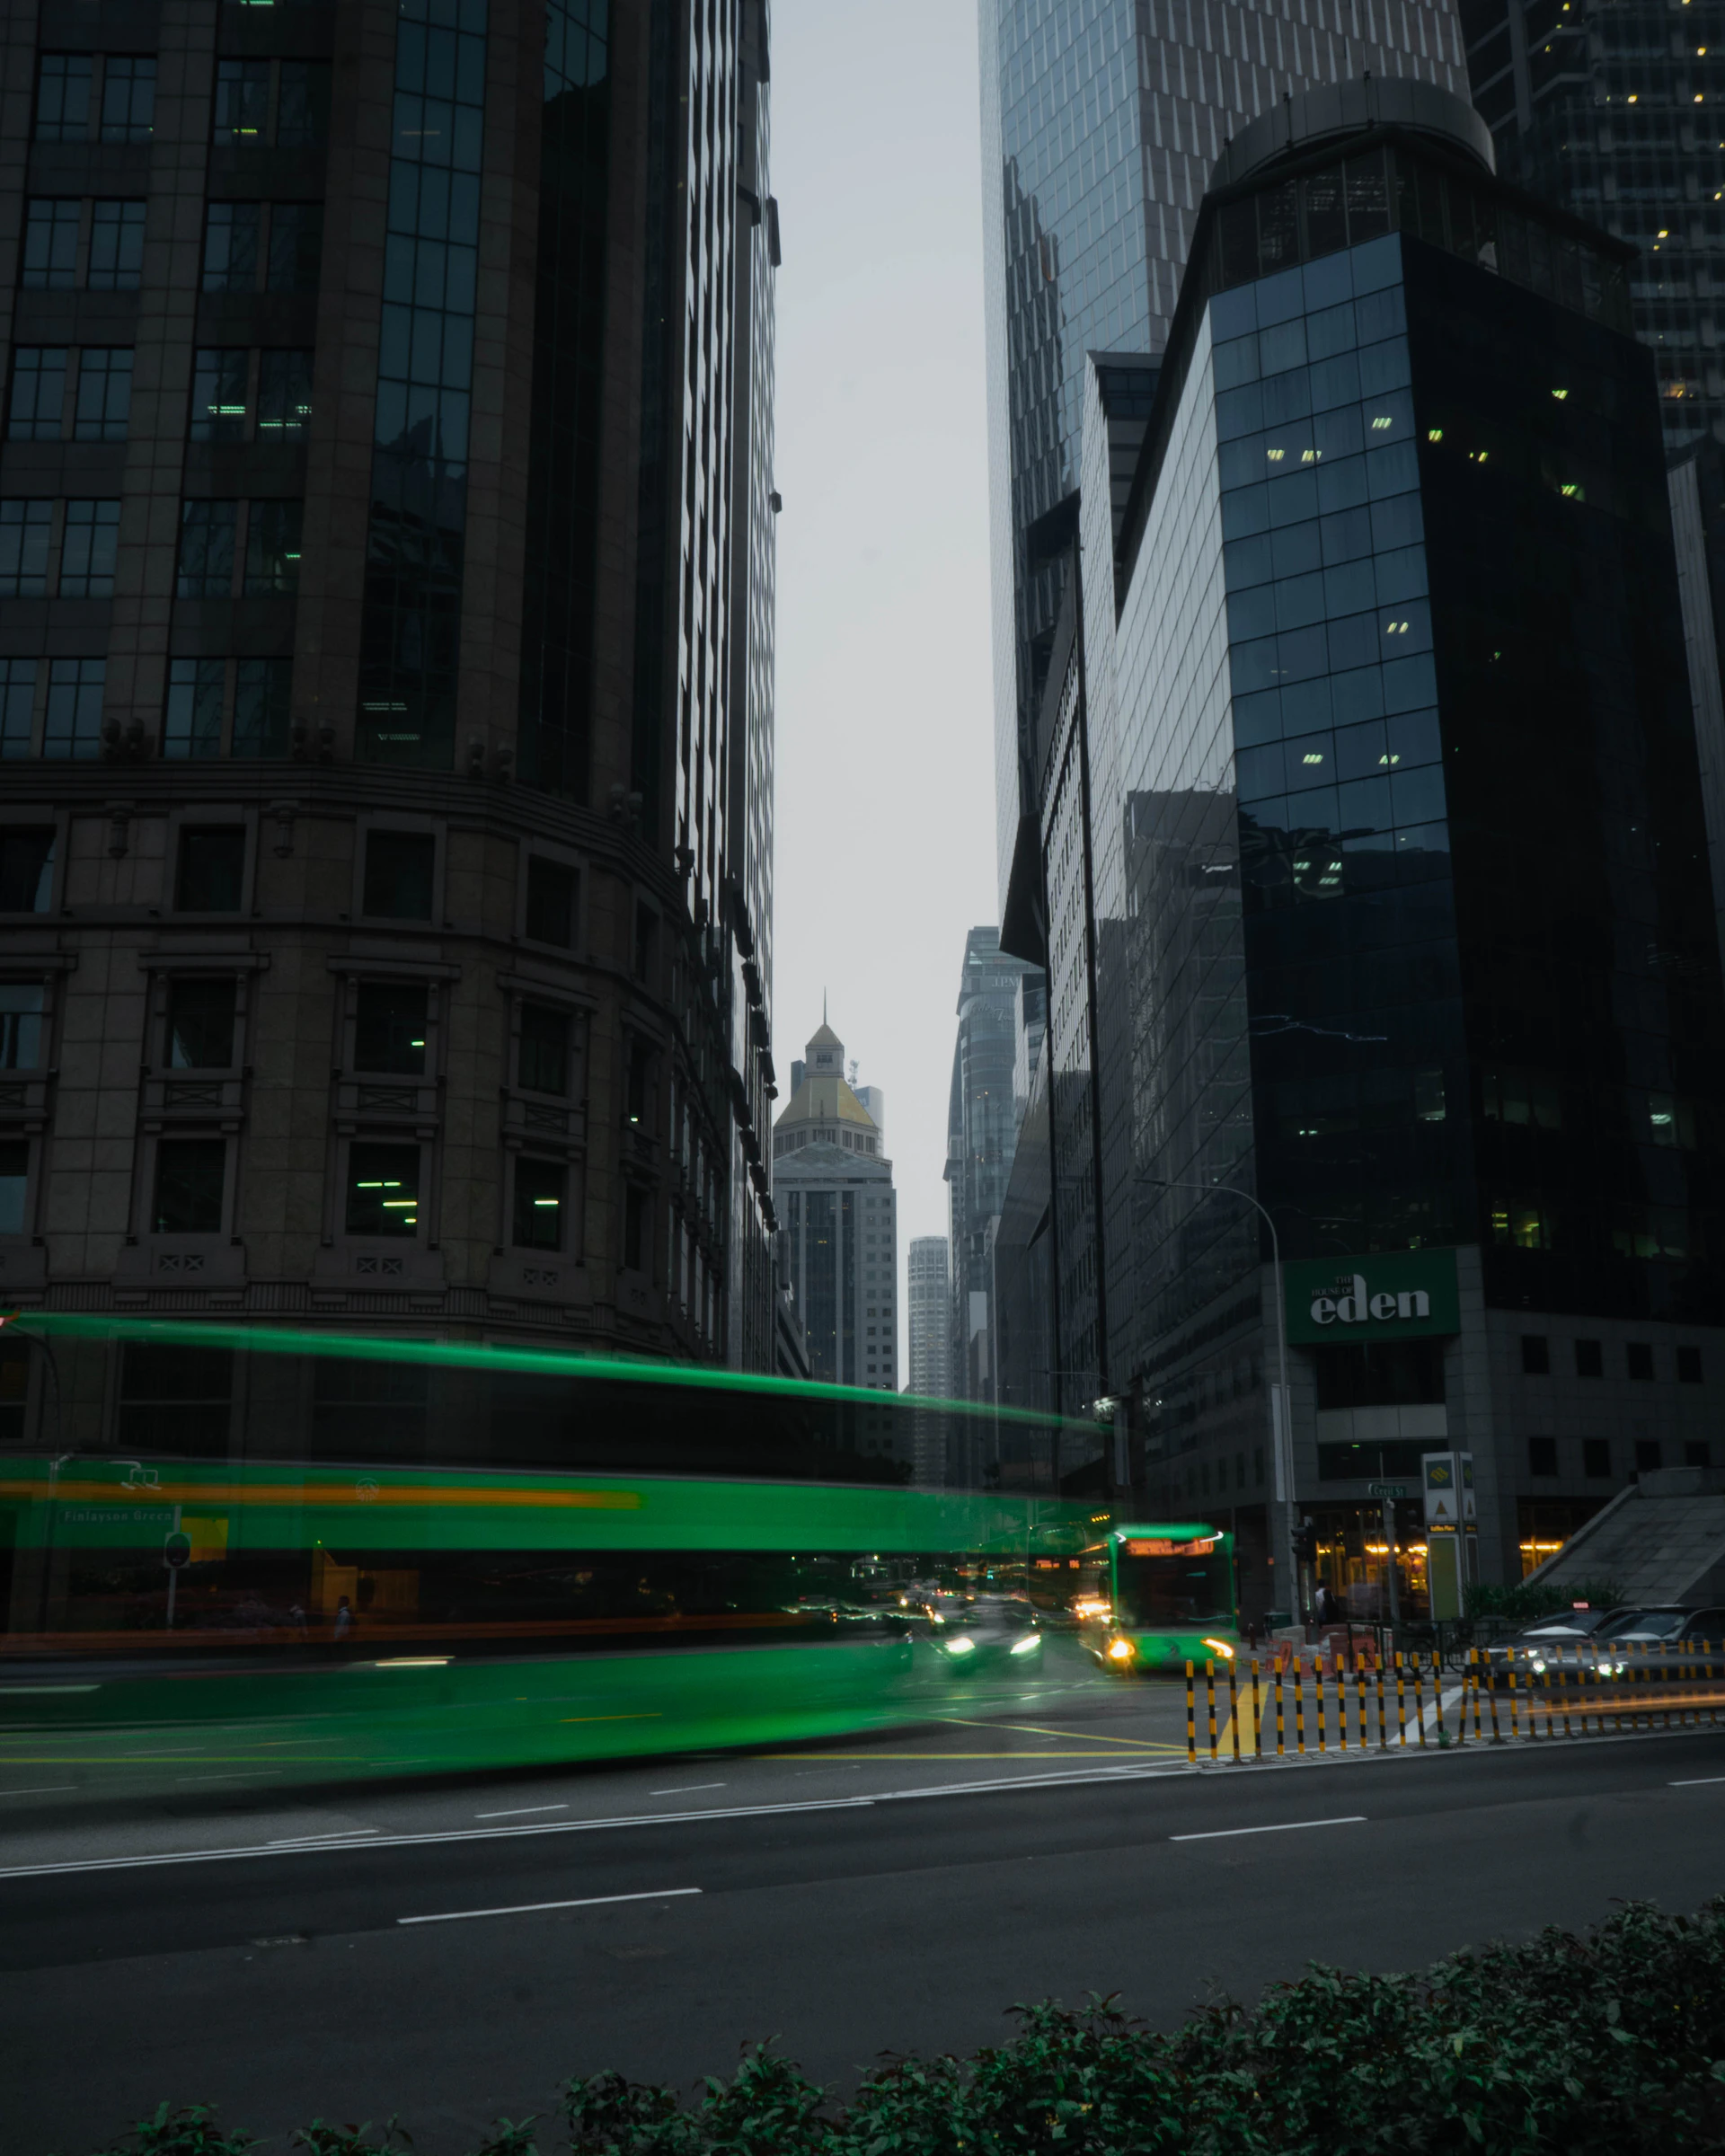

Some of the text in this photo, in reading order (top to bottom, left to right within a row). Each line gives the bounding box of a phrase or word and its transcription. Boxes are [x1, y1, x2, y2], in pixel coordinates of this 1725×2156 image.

[1335, 1276, 1352, 1285] THE
[1311, 1286, 1340, 1296] HOUSE
[1311, 1274, 1430, 1324] eden
[1374, 1485, 1403, 1497] Cecil St
[65, 1509, 172, 1524] Finlayson Green
